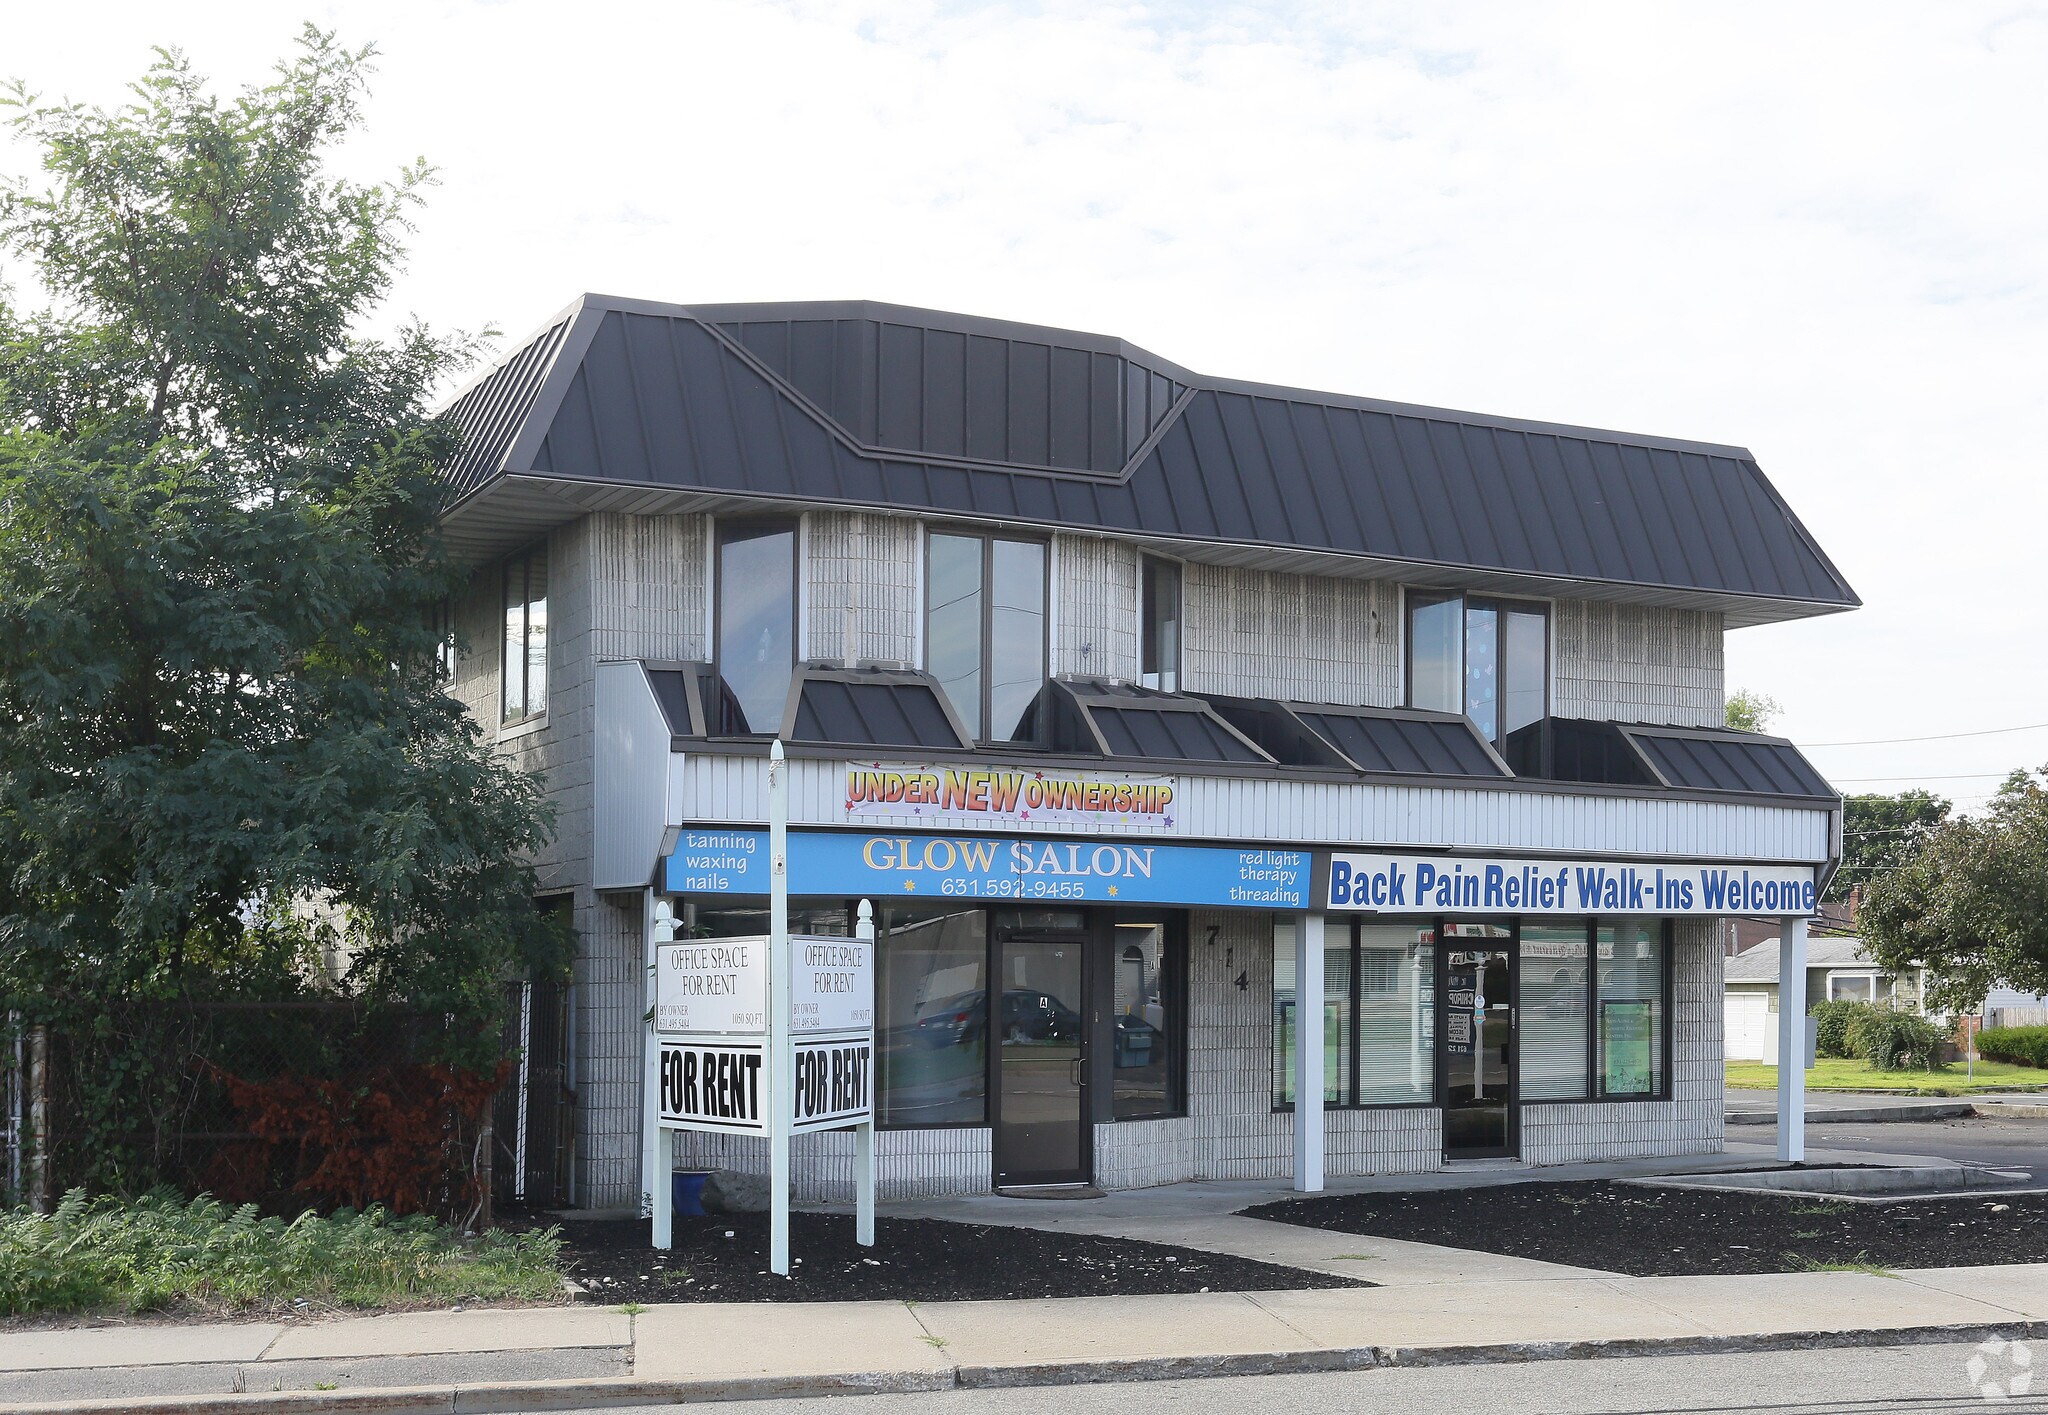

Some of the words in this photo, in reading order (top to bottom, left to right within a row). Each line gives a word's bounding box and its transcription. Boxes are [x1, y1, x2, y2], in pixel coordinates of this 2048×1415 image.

[848, 770, 939, 804] UNDER
[941, 770, 1025, 813] NEW
[1025, 780, 1173, 815] OWNERSHIP
[686, 833, 757, 854] tanning
[685, 853, 747, 874] waxing
[862, 837, 999, 873] GLOW
[1010, 841, 1155, 878] SALON
[1239, 851, 1263, 865] red
[1267, 851, 1301, 869] light
[685, 873, 729, 890] nails
[1240, 866, 1298, 885] therapy
[941, 878, 1085, 898] 631.592-9455
[1229, 885, 1301, 906] threading
[1331, 860, 1405, 906] Back
[1415, 862, 1478, 908] Pain
[1485, 864, 1568, 910] Relief
[1576, 866, 1694, 911] Walk-Ins
[1700, 869, 1815, 913] Welcome
[672, 948, 708, 970] OFFICE
[711, 946, 748, 969] SPACE
[805, 945, 837, 967] OFFICE
[839, 946, 862, 967] SPACE
[683, 974, 704, 996] FOR
[706, 974, 737, 995] RENT
[814, 973, 832, 993] FOR
[834, 973, 855, 993] RENT
[659, 1005, 667, 1015] BY
[668, 1005, 688, 1016] OWNER
[745, 1013, 754, 1025] SQ
[793, 1004, 801, 1015] BY
[802, 1003, 819, 1014] OWNER
[661, 1050, 698, 1114] FOR
[702, 1052, 762, 1120] RENT
[794, 1050, 828, 1119] FOR
[831, 1047, 870, 1112] RENT
